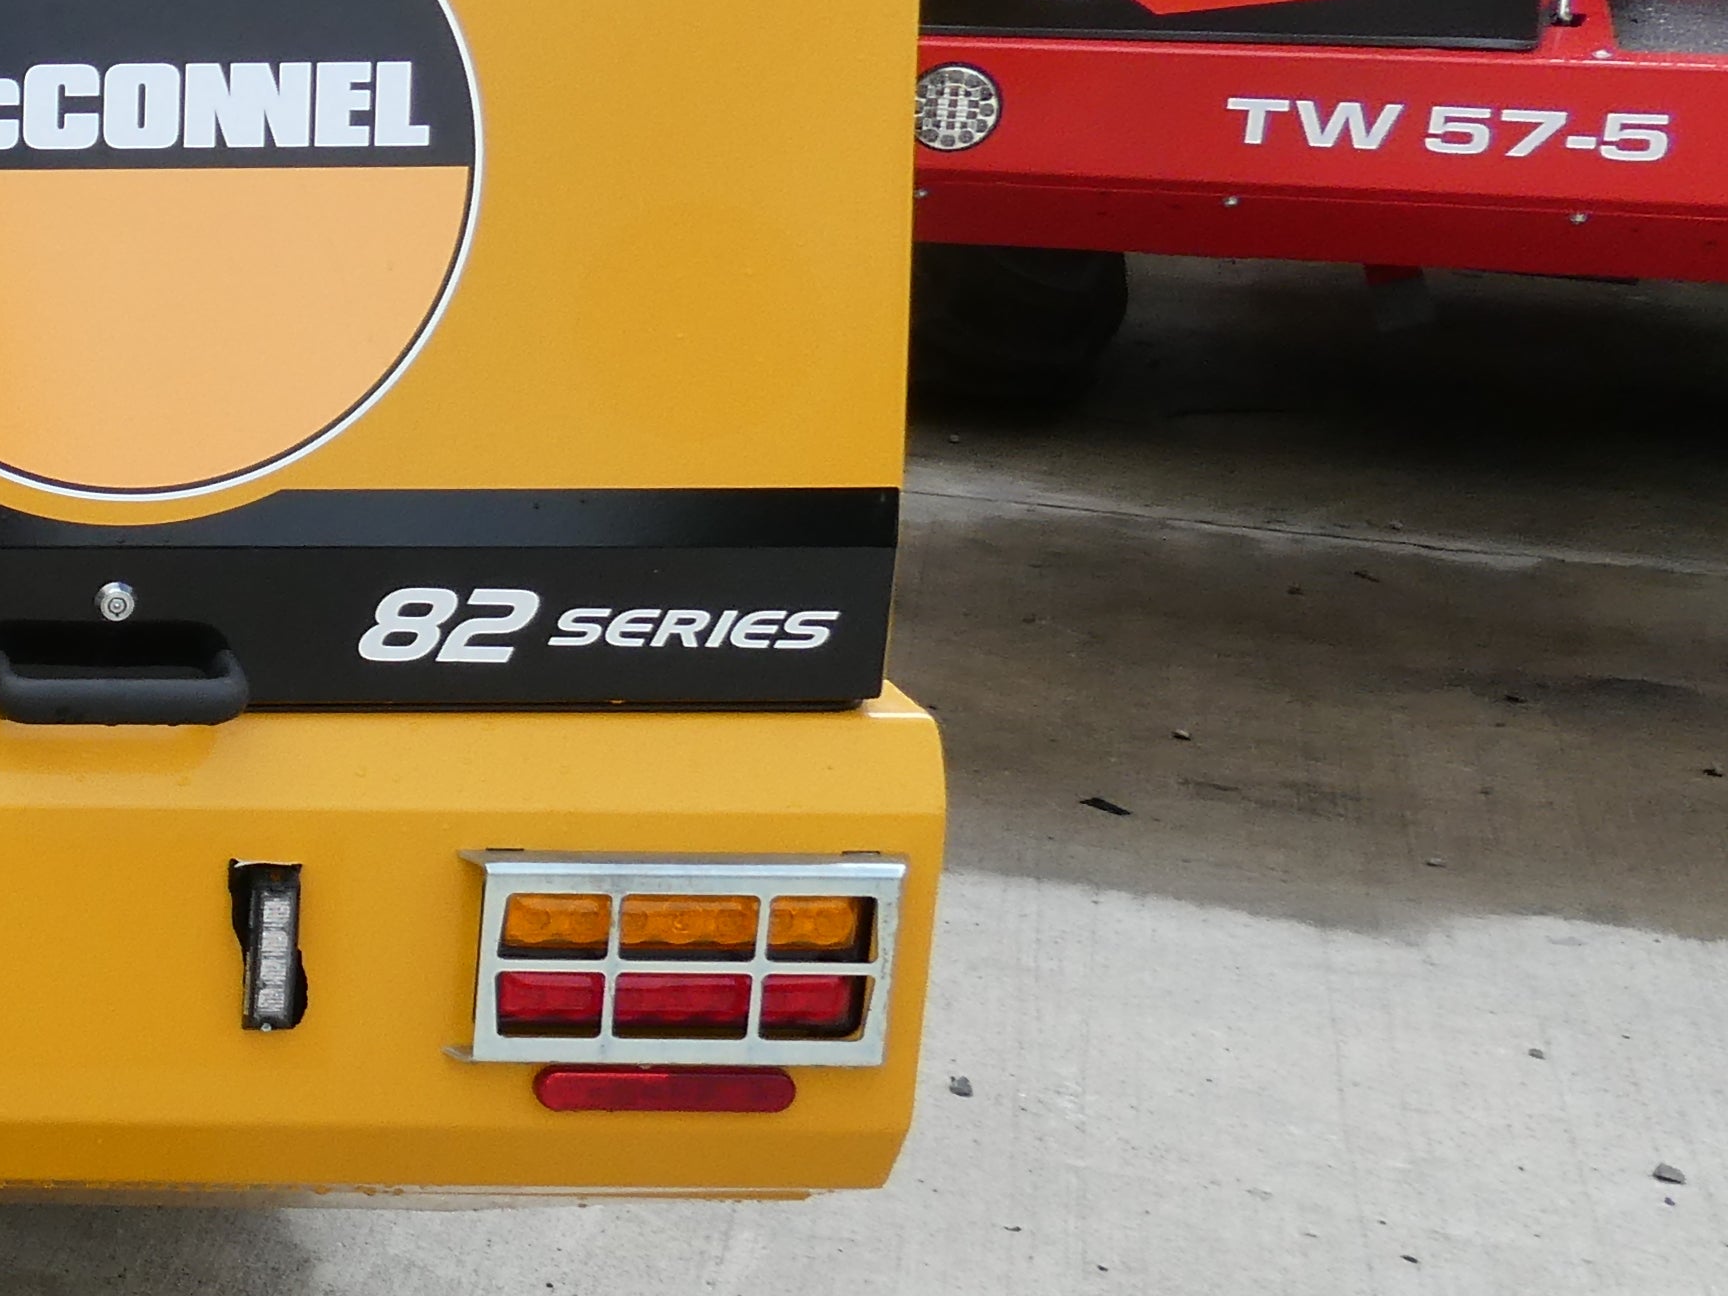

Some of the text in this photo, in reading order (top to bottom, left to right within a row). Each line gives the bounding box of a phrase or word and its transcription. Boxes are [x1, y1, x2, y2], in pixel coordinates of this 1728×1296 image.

[1226, 98, 1672, 162] TW 57-5
[358, 587, 841, 664] 82 SERIES
